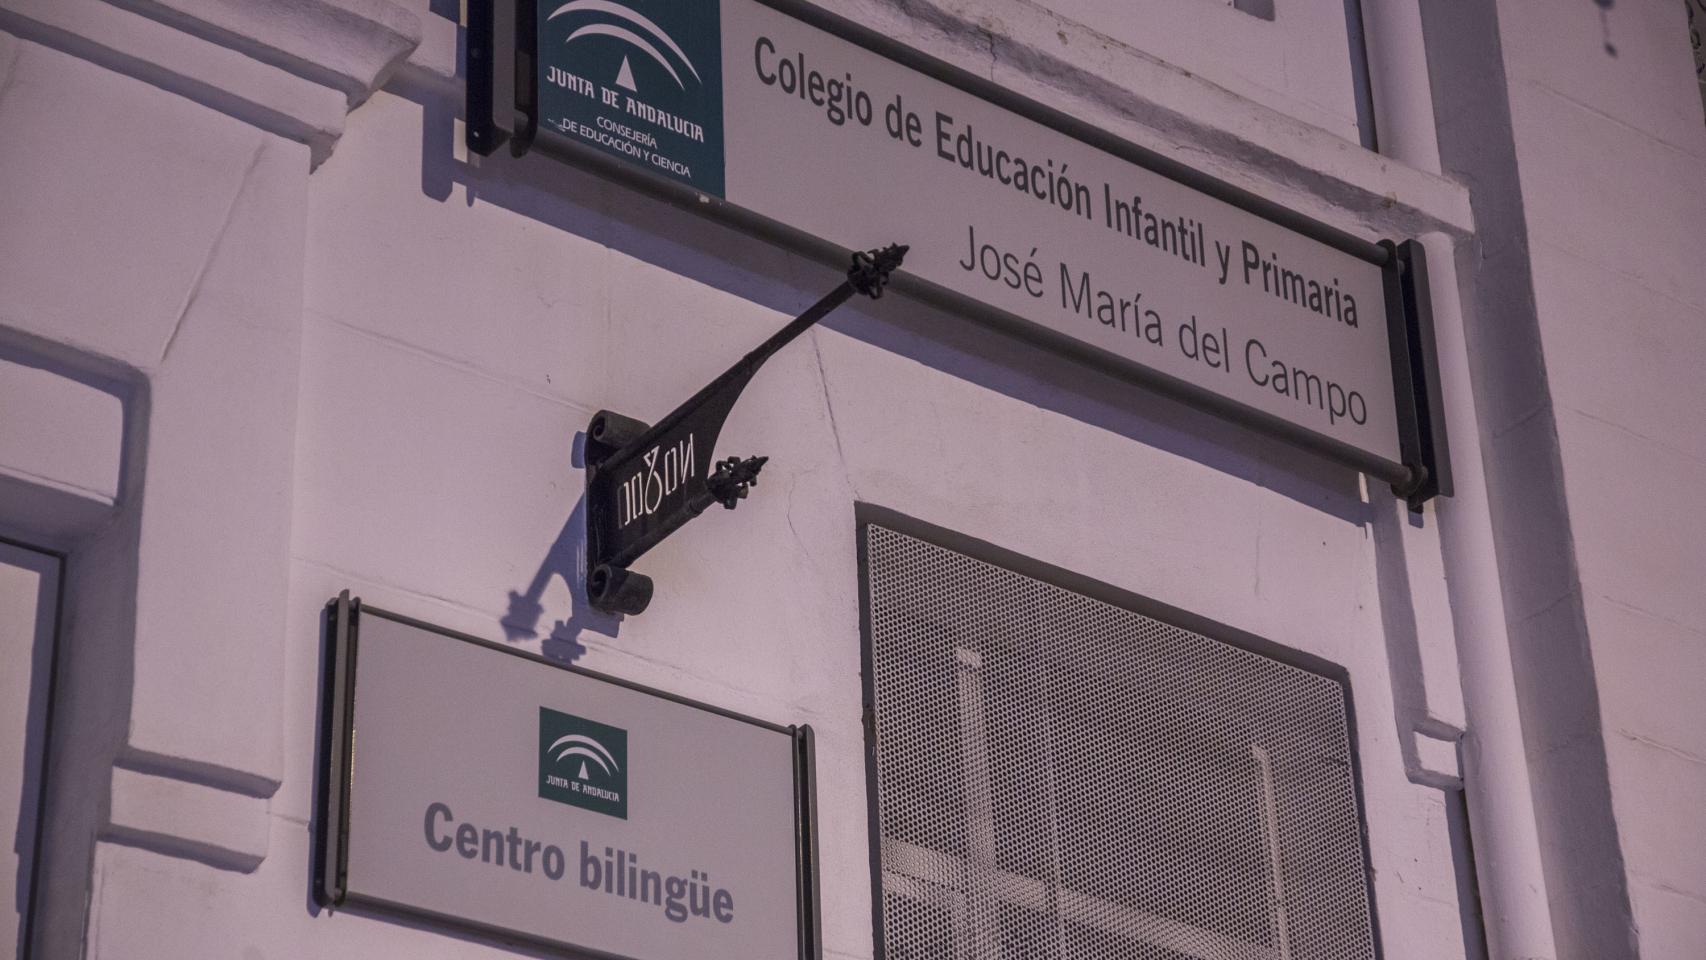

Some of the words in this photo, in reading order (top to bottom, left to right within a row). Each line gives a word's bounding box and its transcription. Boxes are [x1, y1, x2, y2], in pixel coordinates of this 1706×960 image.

[547, 66, 595, 99] JUNTA
[601, 86, 619, 108] DE
[562, 118, 577, 132] DE
[579, 125, 641, 159] EDUCACIÓN
[643, 150, 650, 161] Y
[651, 153, 691, 178] CIENCIA
[596, 116, 658, 149] CONSEJERÍA
[755, 37, 872, 126] Colegio
[885, 95, 922, 147] de
[935, 111, 1092, 220] Educación
[1104, 183, 1205, 267] Infantil
[1215, 240, 1231, 285] y
[1241, 240, 1358, 328] Primaria
[959, 225, 1044, 298] José
[1060, 262, 1163, 347] María
[1178, 315, 1230, 373] del
[1245, 338, 1367, 426] Campo
[546, 775, 569, 788] JUNTA
[571, 781, 580, 791] DE
[424, 802, 565, 880] Centro
[579, 840, 734, 923] bilingüe
